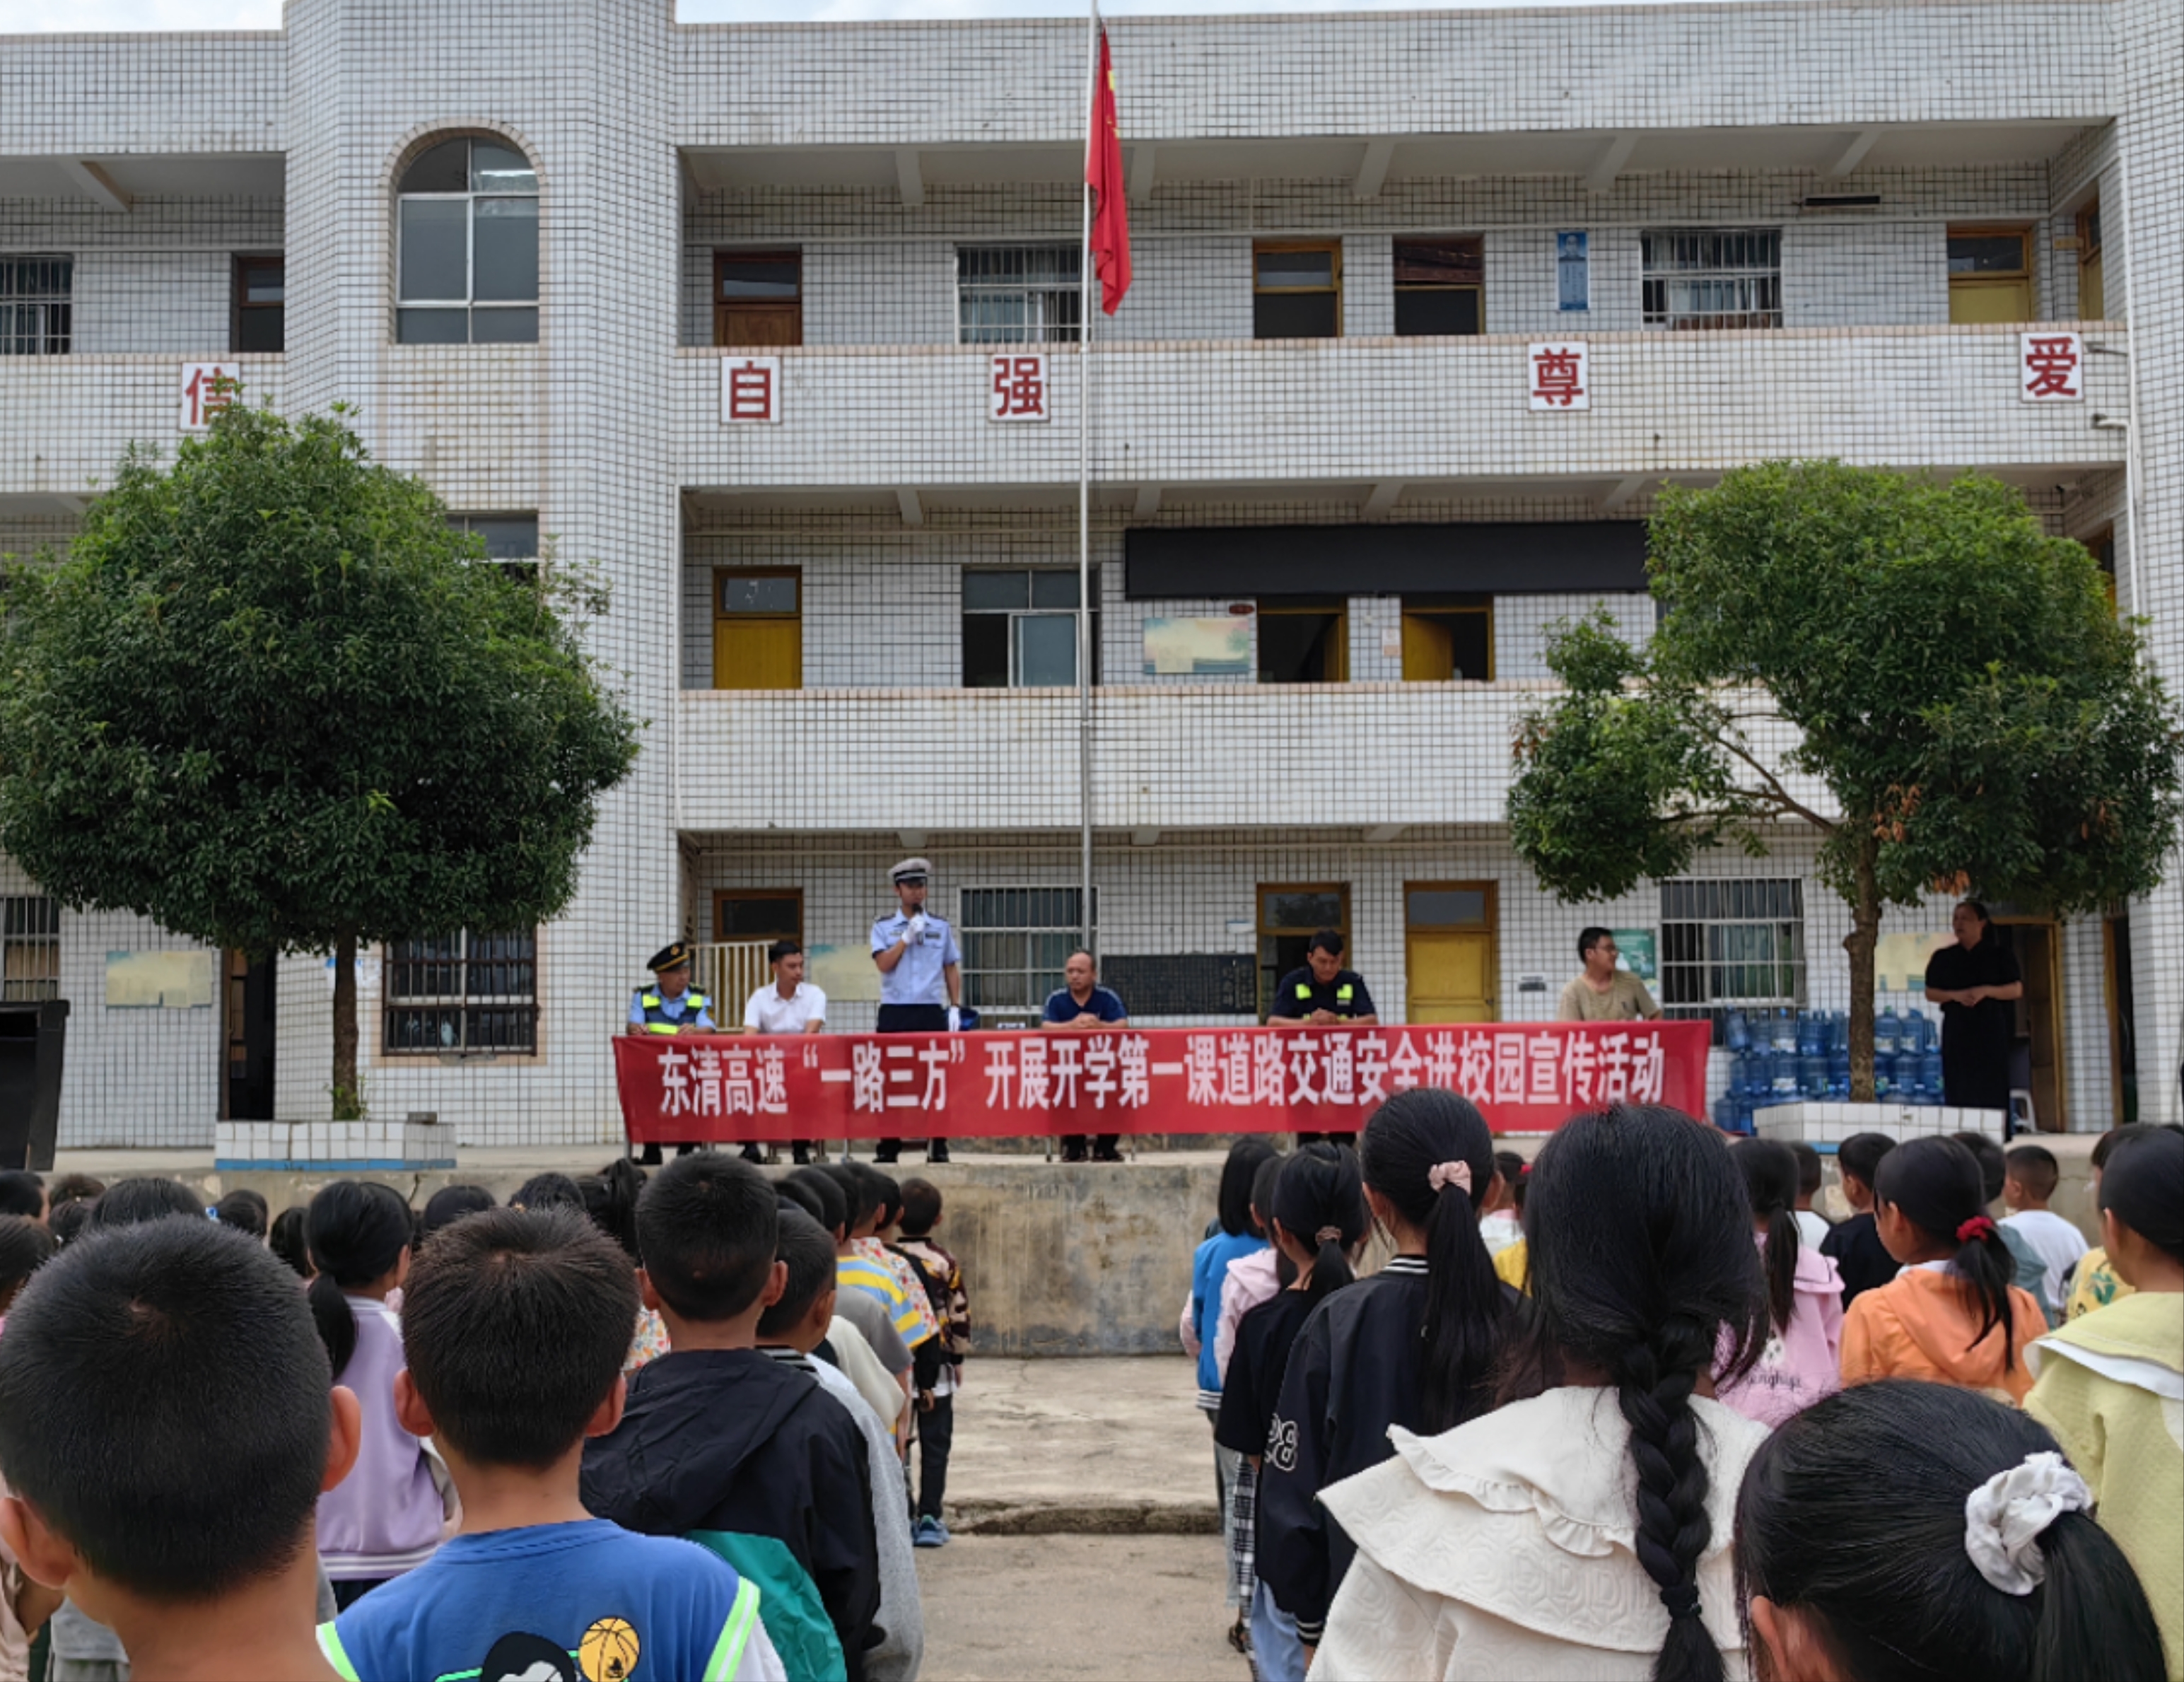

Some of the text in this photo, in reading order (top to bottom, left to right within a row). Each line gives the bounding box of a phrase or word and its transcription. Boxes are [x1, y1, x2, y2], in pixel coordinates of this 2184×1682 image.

[185, 366, 235, 425] 信
[730, 361, 771, 419] 自
[993, 358, 1044, 416] 强
[1532, 347, 1584, 407] 尊
[2026, 336, 2077, 397] 爱
